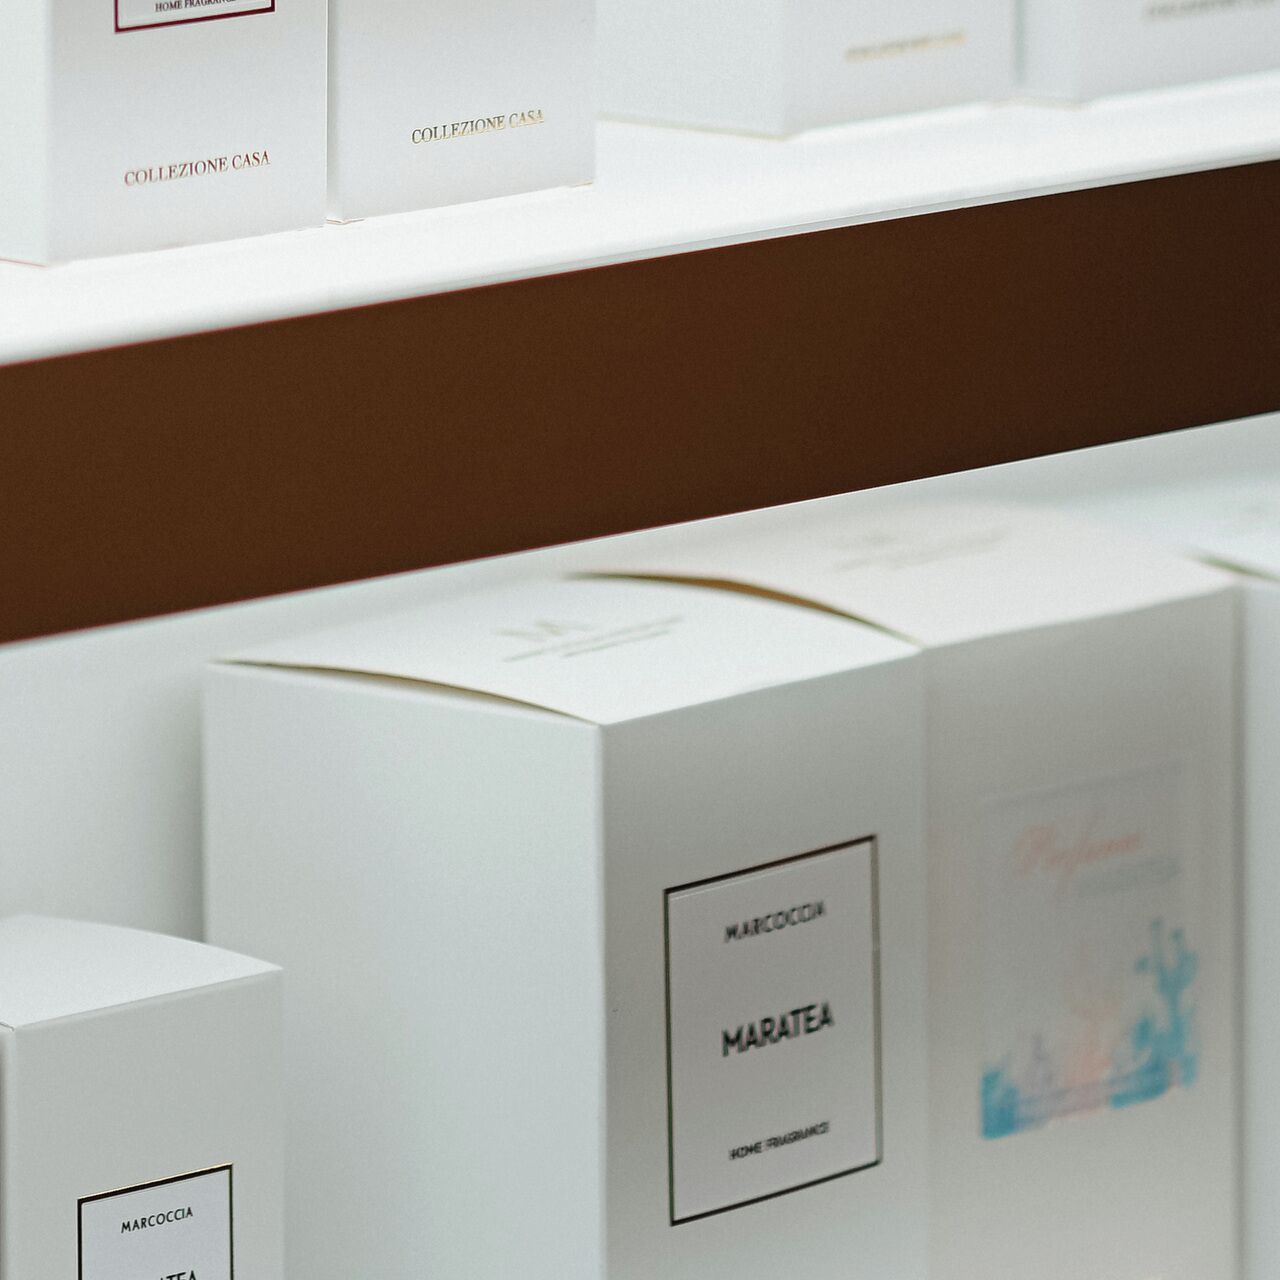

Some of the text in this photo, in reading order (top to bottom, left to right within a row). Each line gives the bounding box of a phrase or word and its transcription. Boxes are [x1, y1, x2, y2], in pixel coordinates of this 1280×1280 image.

[155, 0, 183, 13] HOME
[411, 109, 545, 144] COLLEZIONE CASA
[124, 149, 271, 186] COLLEZIONE CASA
[724, 900, 827, 943] MARCOCCIA
[721, 1000, 835, 1058] MARATEA
[120, 1206, 194, 1234] MARCOCCIA
